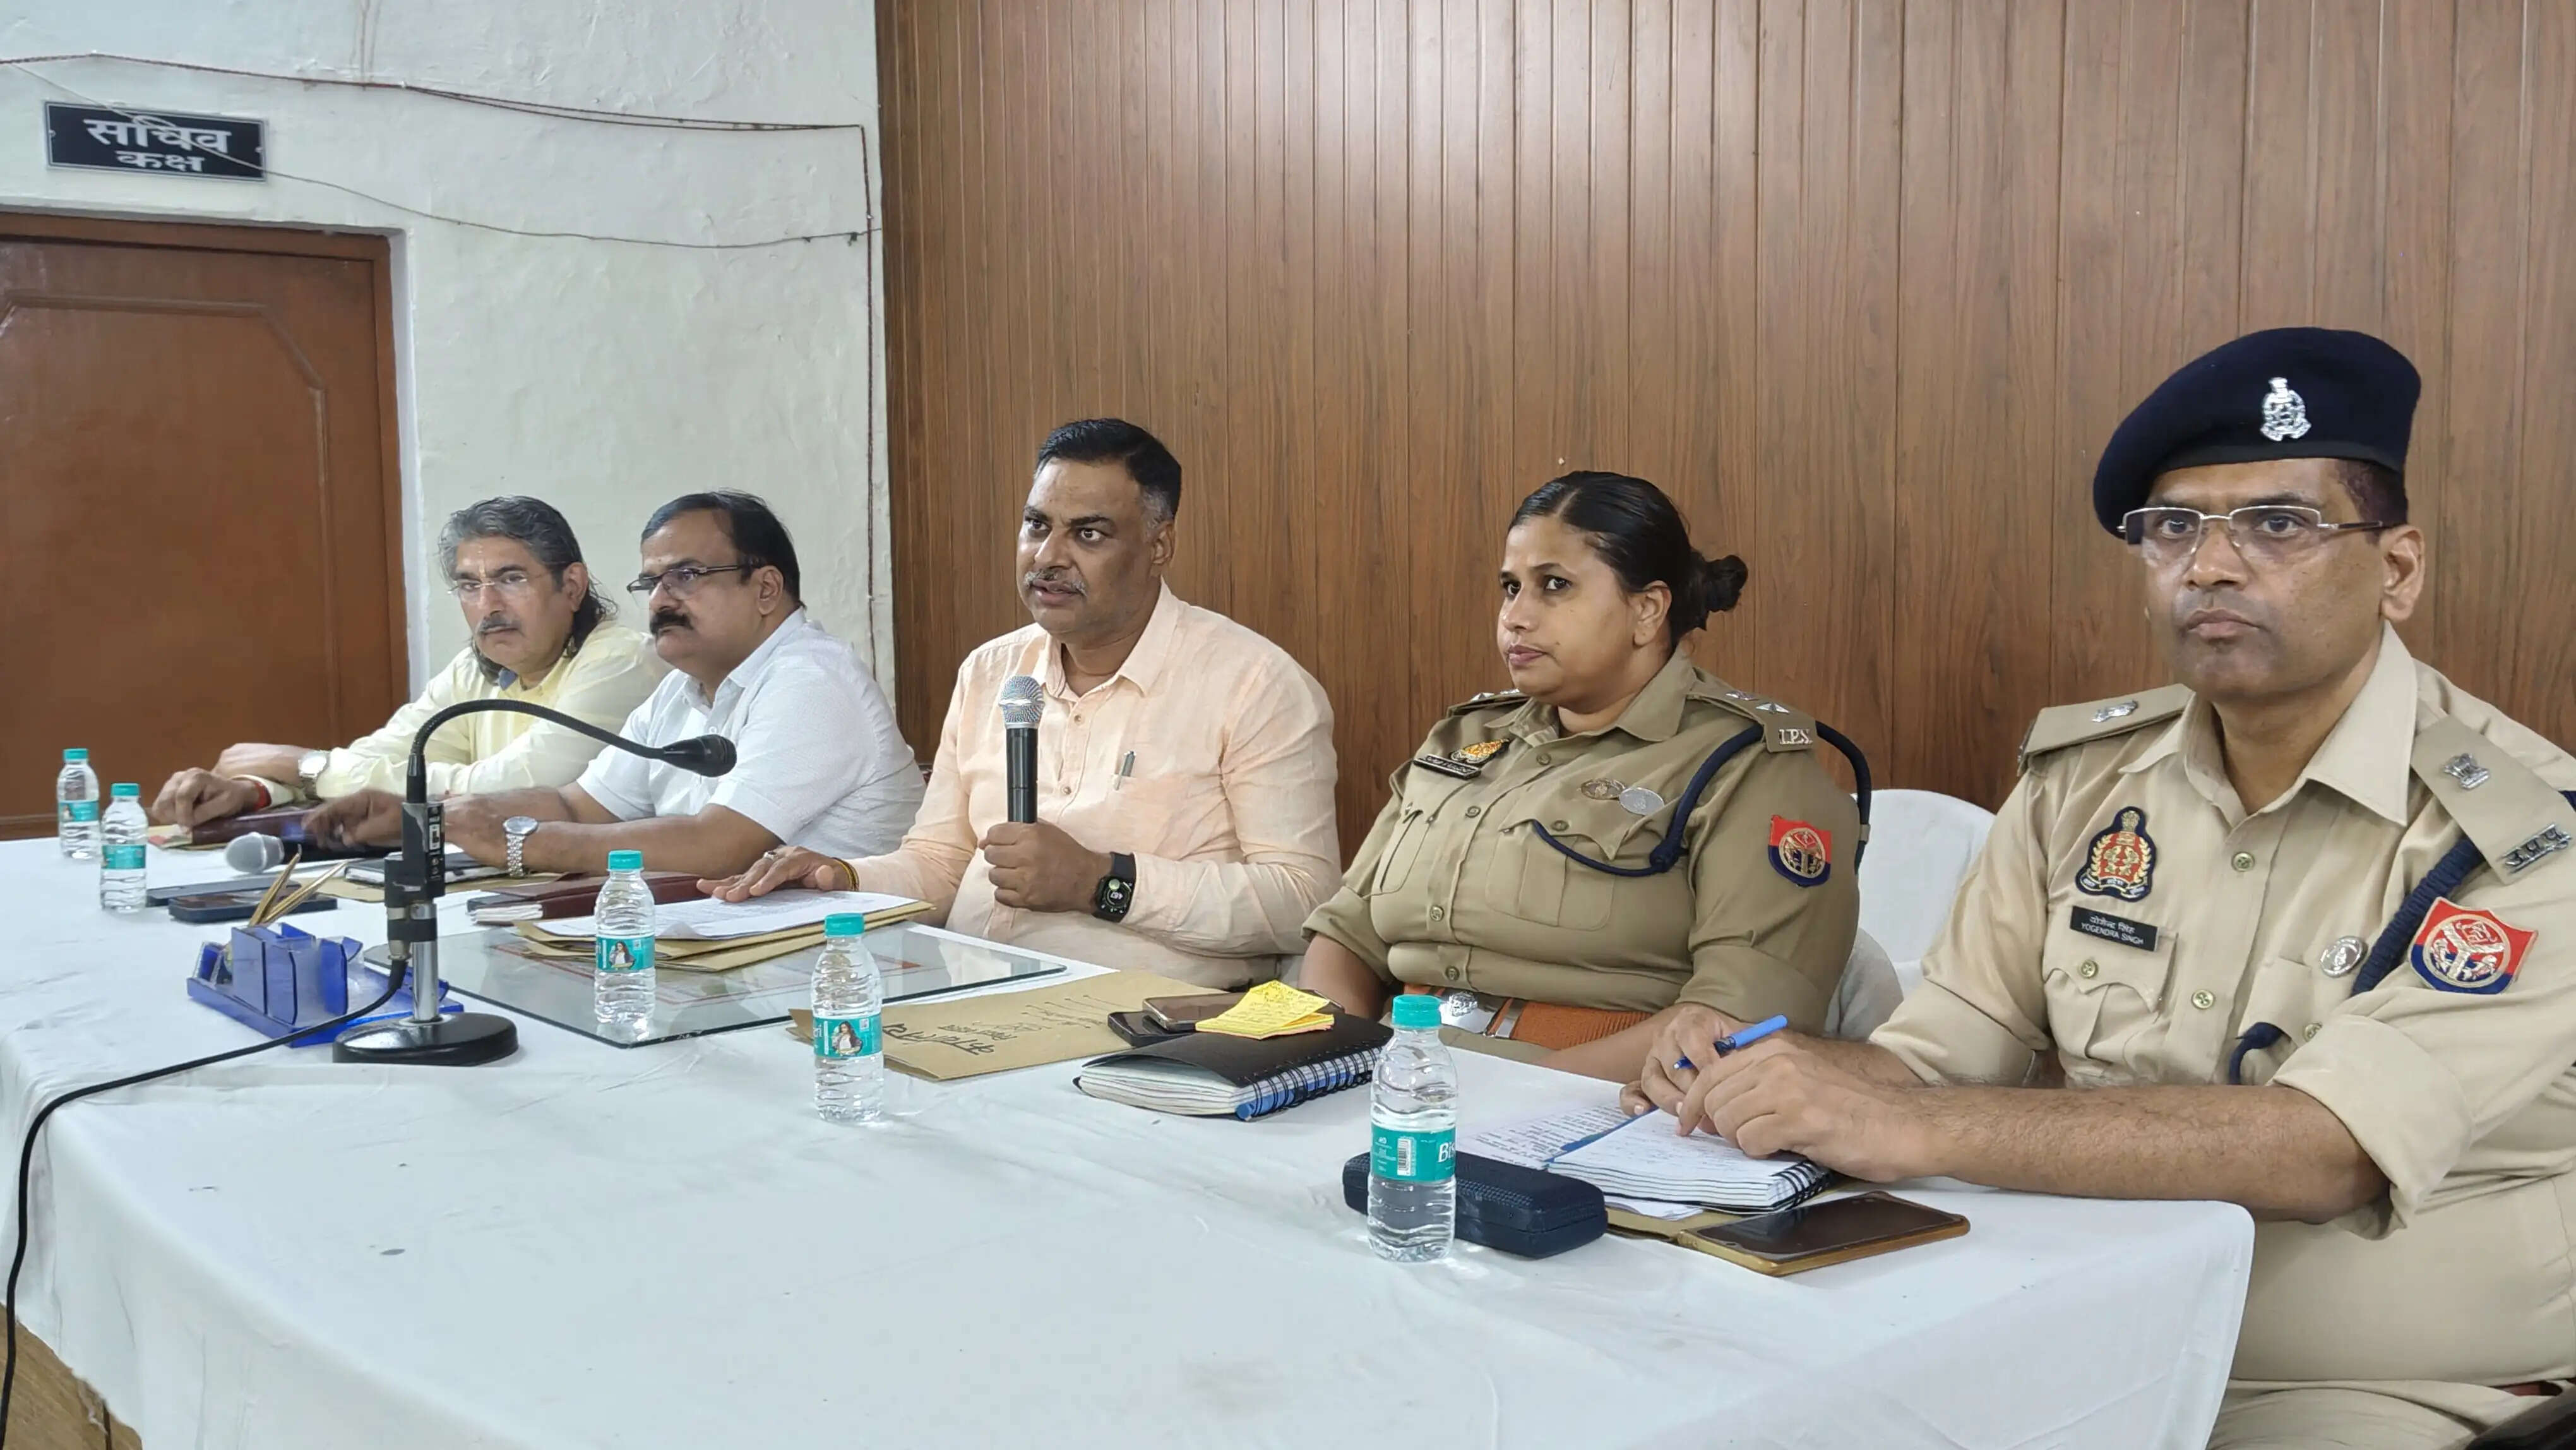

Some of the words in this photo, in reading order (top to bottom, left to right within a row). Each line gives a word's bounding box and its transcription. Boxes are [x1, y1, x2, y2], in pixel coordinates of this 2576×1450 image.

[83, 115, 232, 153] सचिव
[115, 150, 205, 172] कक्ष
[2081, 923, 2120, 939] YOGENDRA
[2121, 932, 2144, 945] SINGH
